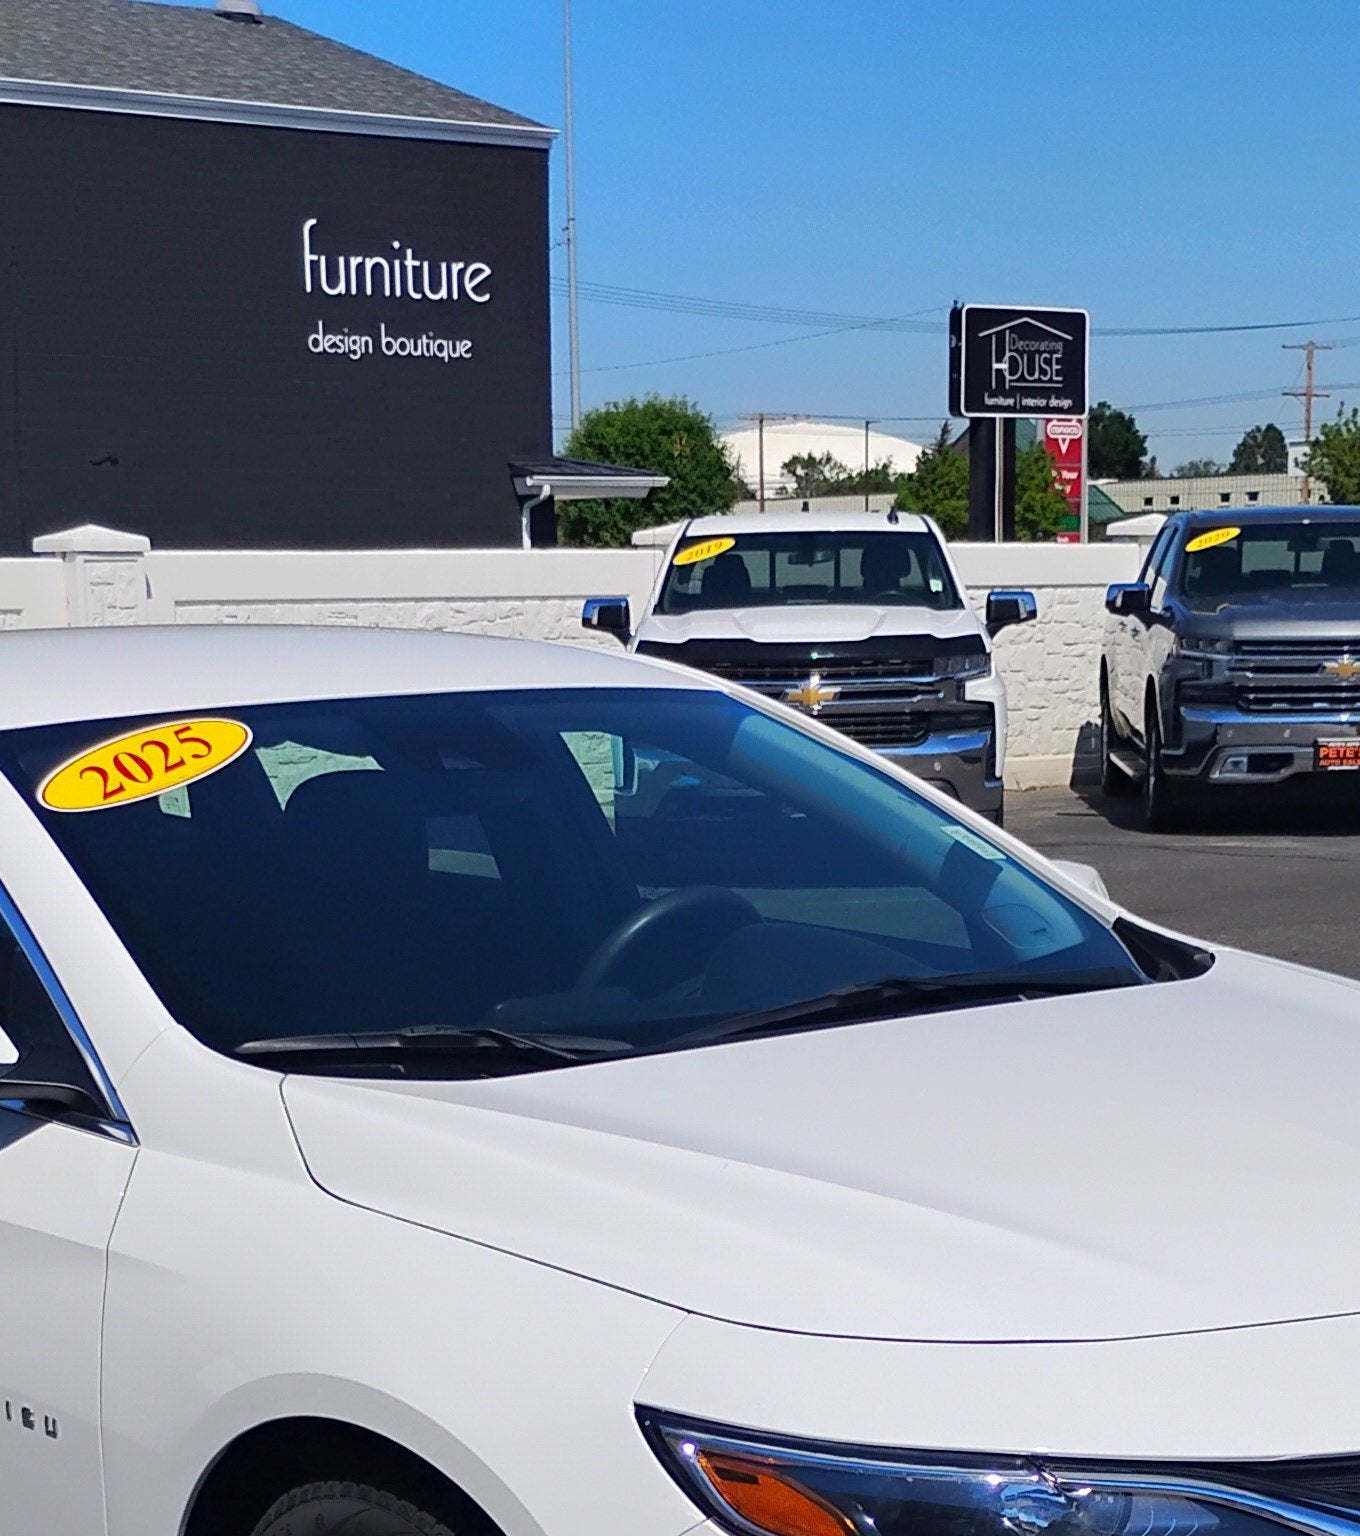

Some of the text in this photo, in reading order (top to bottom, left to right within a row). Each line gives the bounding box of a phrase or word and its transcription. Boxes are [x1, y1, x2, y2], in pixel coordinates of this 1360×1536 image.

[302, 217, 492, 303] furniture
[307, 320, 473, 362] design boutique
[991, 329, 1064, 390] HOUSE
[1009, 333, 1064, 355] Decorating
[983, 392, 1015, 407] furniture
[79, 725, 212, 801] 2025
